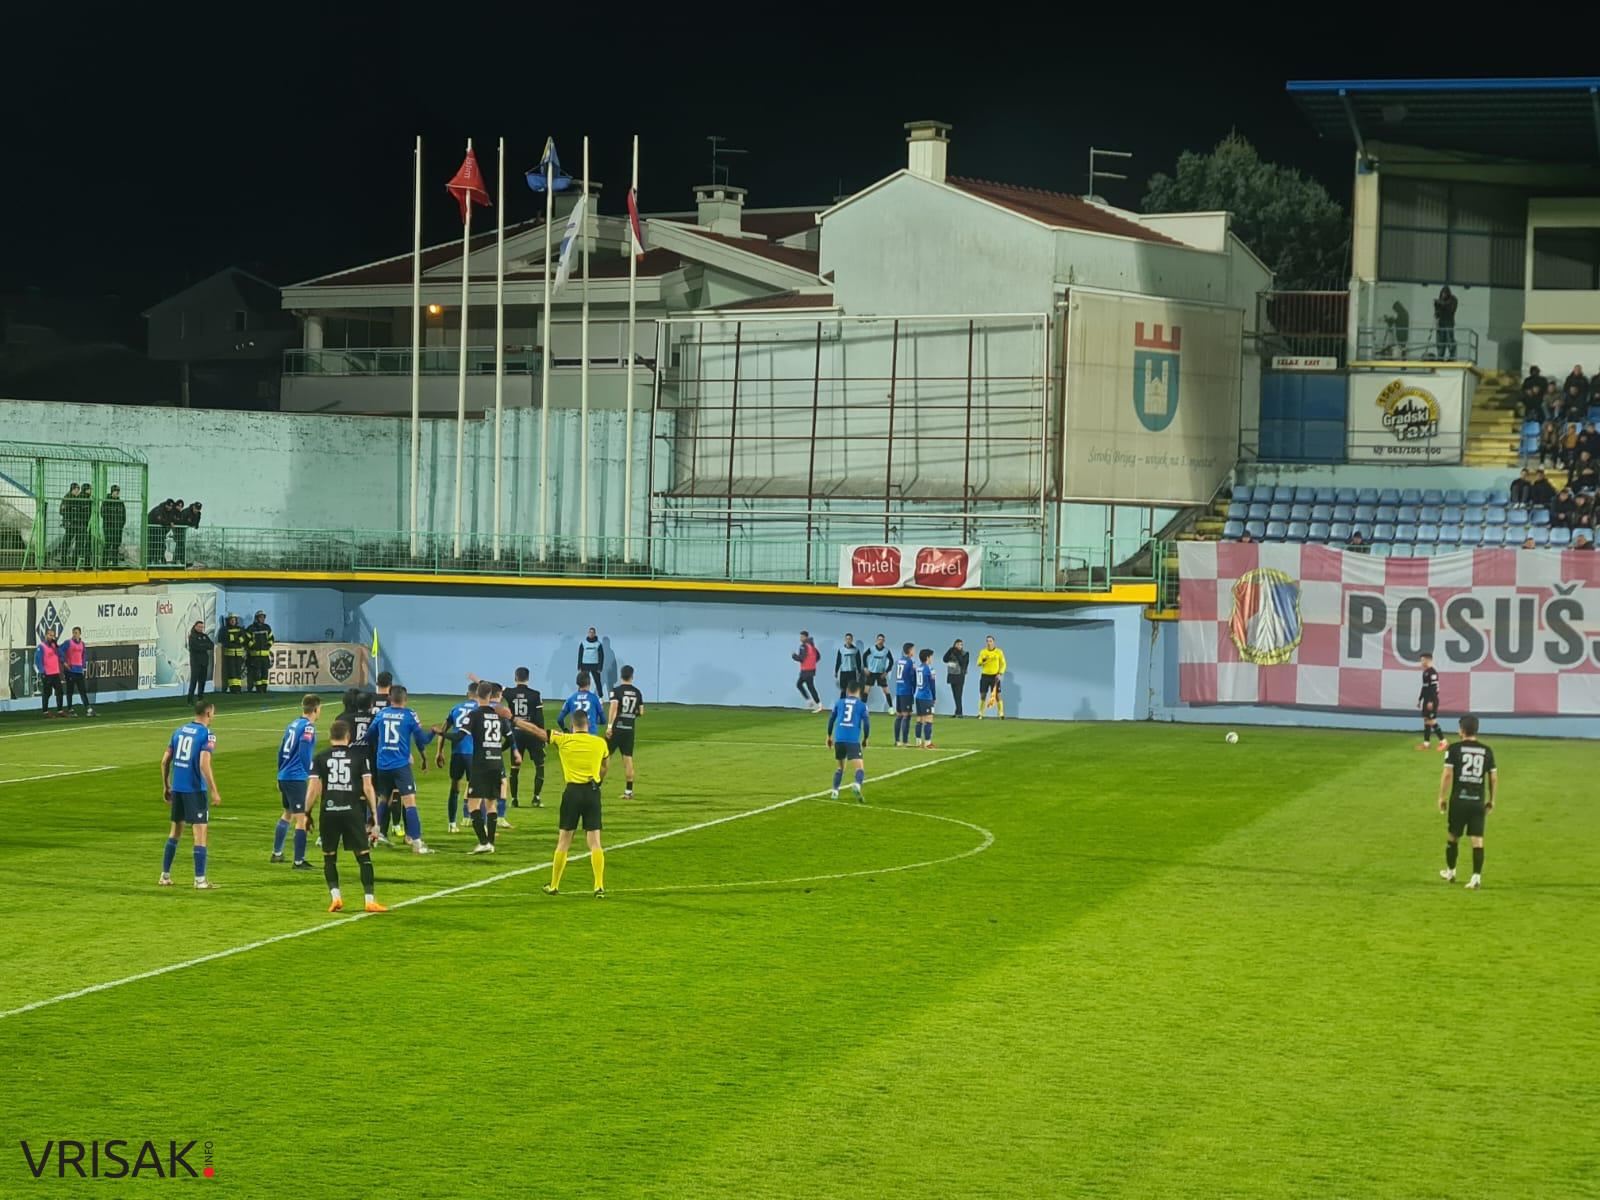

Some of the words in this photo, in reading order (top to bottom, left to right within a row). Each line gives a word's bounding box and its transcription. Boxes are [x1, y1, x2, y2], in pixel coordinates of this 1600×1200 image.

[1383, 410, 1429, 426] Gradski
[1395, 421, 1437, 440] Taxi
[857, 557, 895, 574] m:tel
[920, 560, 962, 576] m:tel
[97, 604, 115, 617] NET
[117, 604, 138, 617] d.o.o
[83, 660, 111, 679] HOTEL
[112, 658, 134, 677] PARK
[268, 671, 319, 685] ECURITY
[512, 699, 528, 716] 15
[622, 696, 637, 713] 97
[844, 704, 853, 722] 3
[383, 720, 401, 744] 15
[484, 720, 501, 741] 23
[175, 735, 193, 761] 19
[326, 758, 351, 784] 35
[1461, 753, 1485, 777] 29
